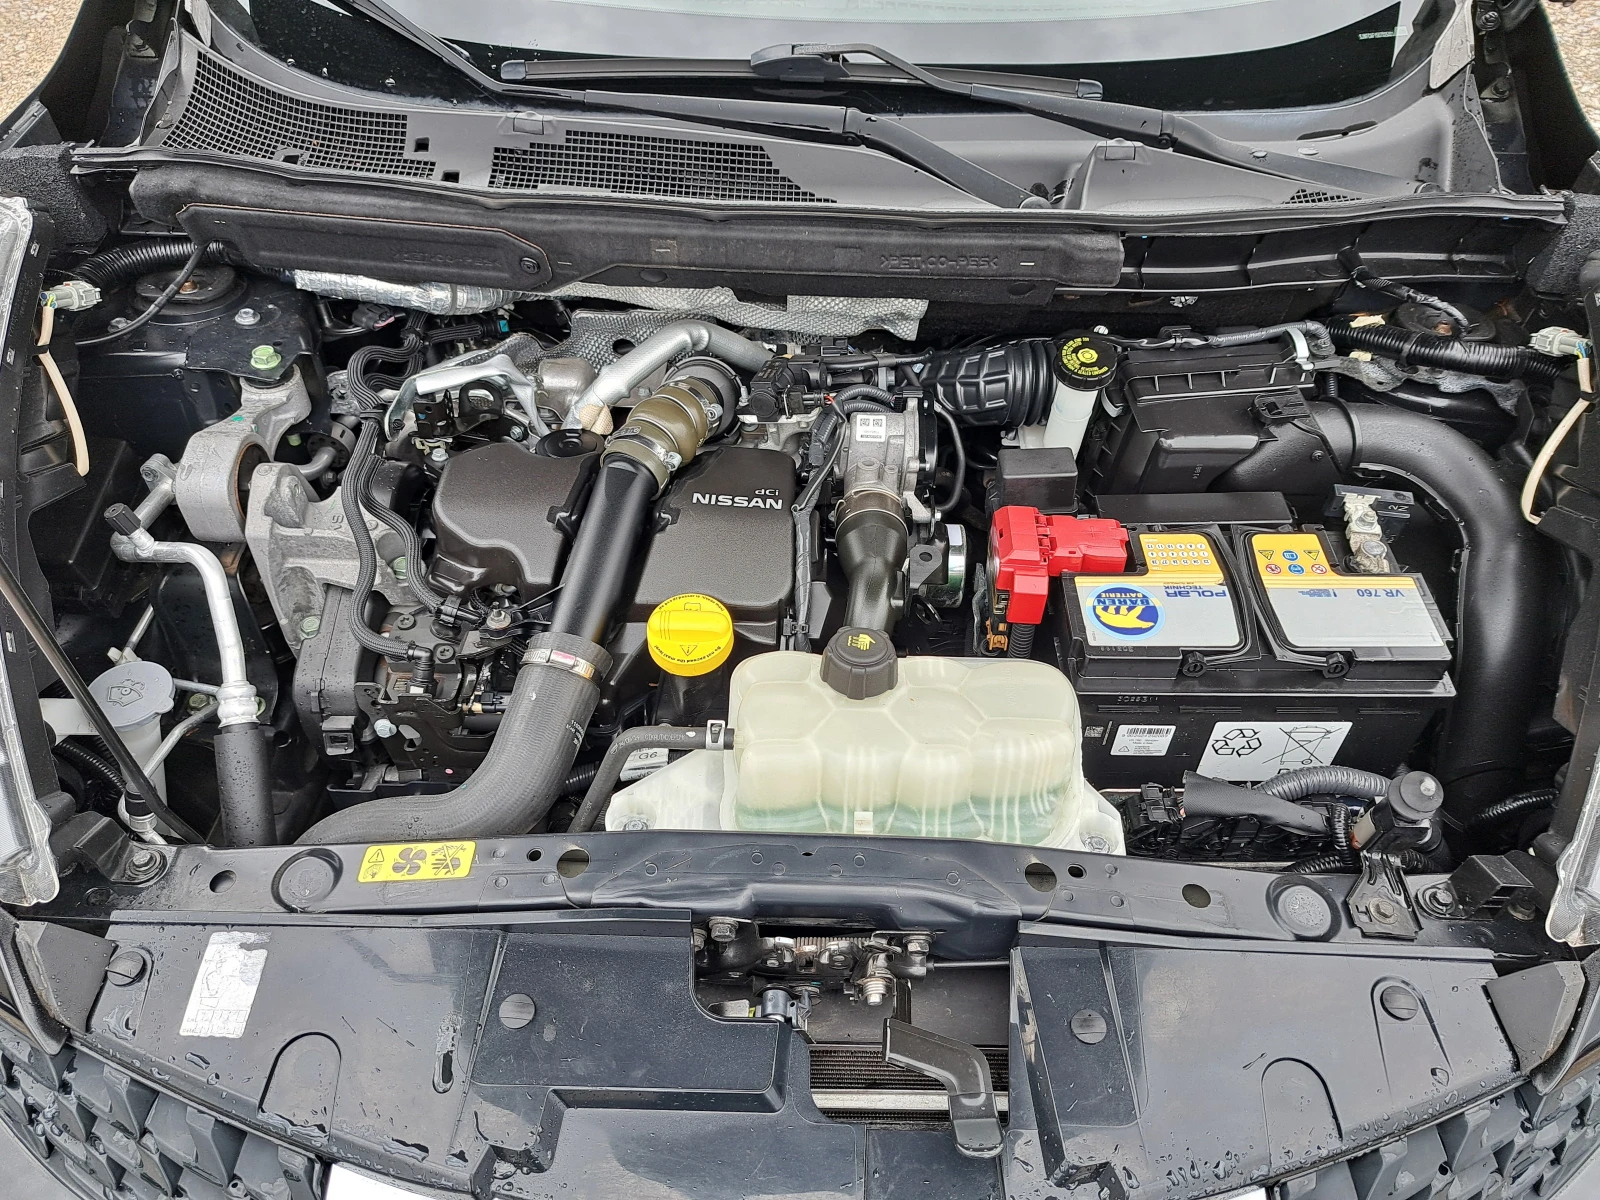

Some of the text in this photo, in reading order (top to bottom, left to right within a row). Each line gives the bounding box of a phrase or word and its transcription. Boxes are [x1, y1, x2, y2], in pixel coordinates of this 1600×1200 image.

[754, 488, 780, 496] dCi
[692, 492, 783, 510] NISSAN
[1356, 588, 1405, 598] VR 760
